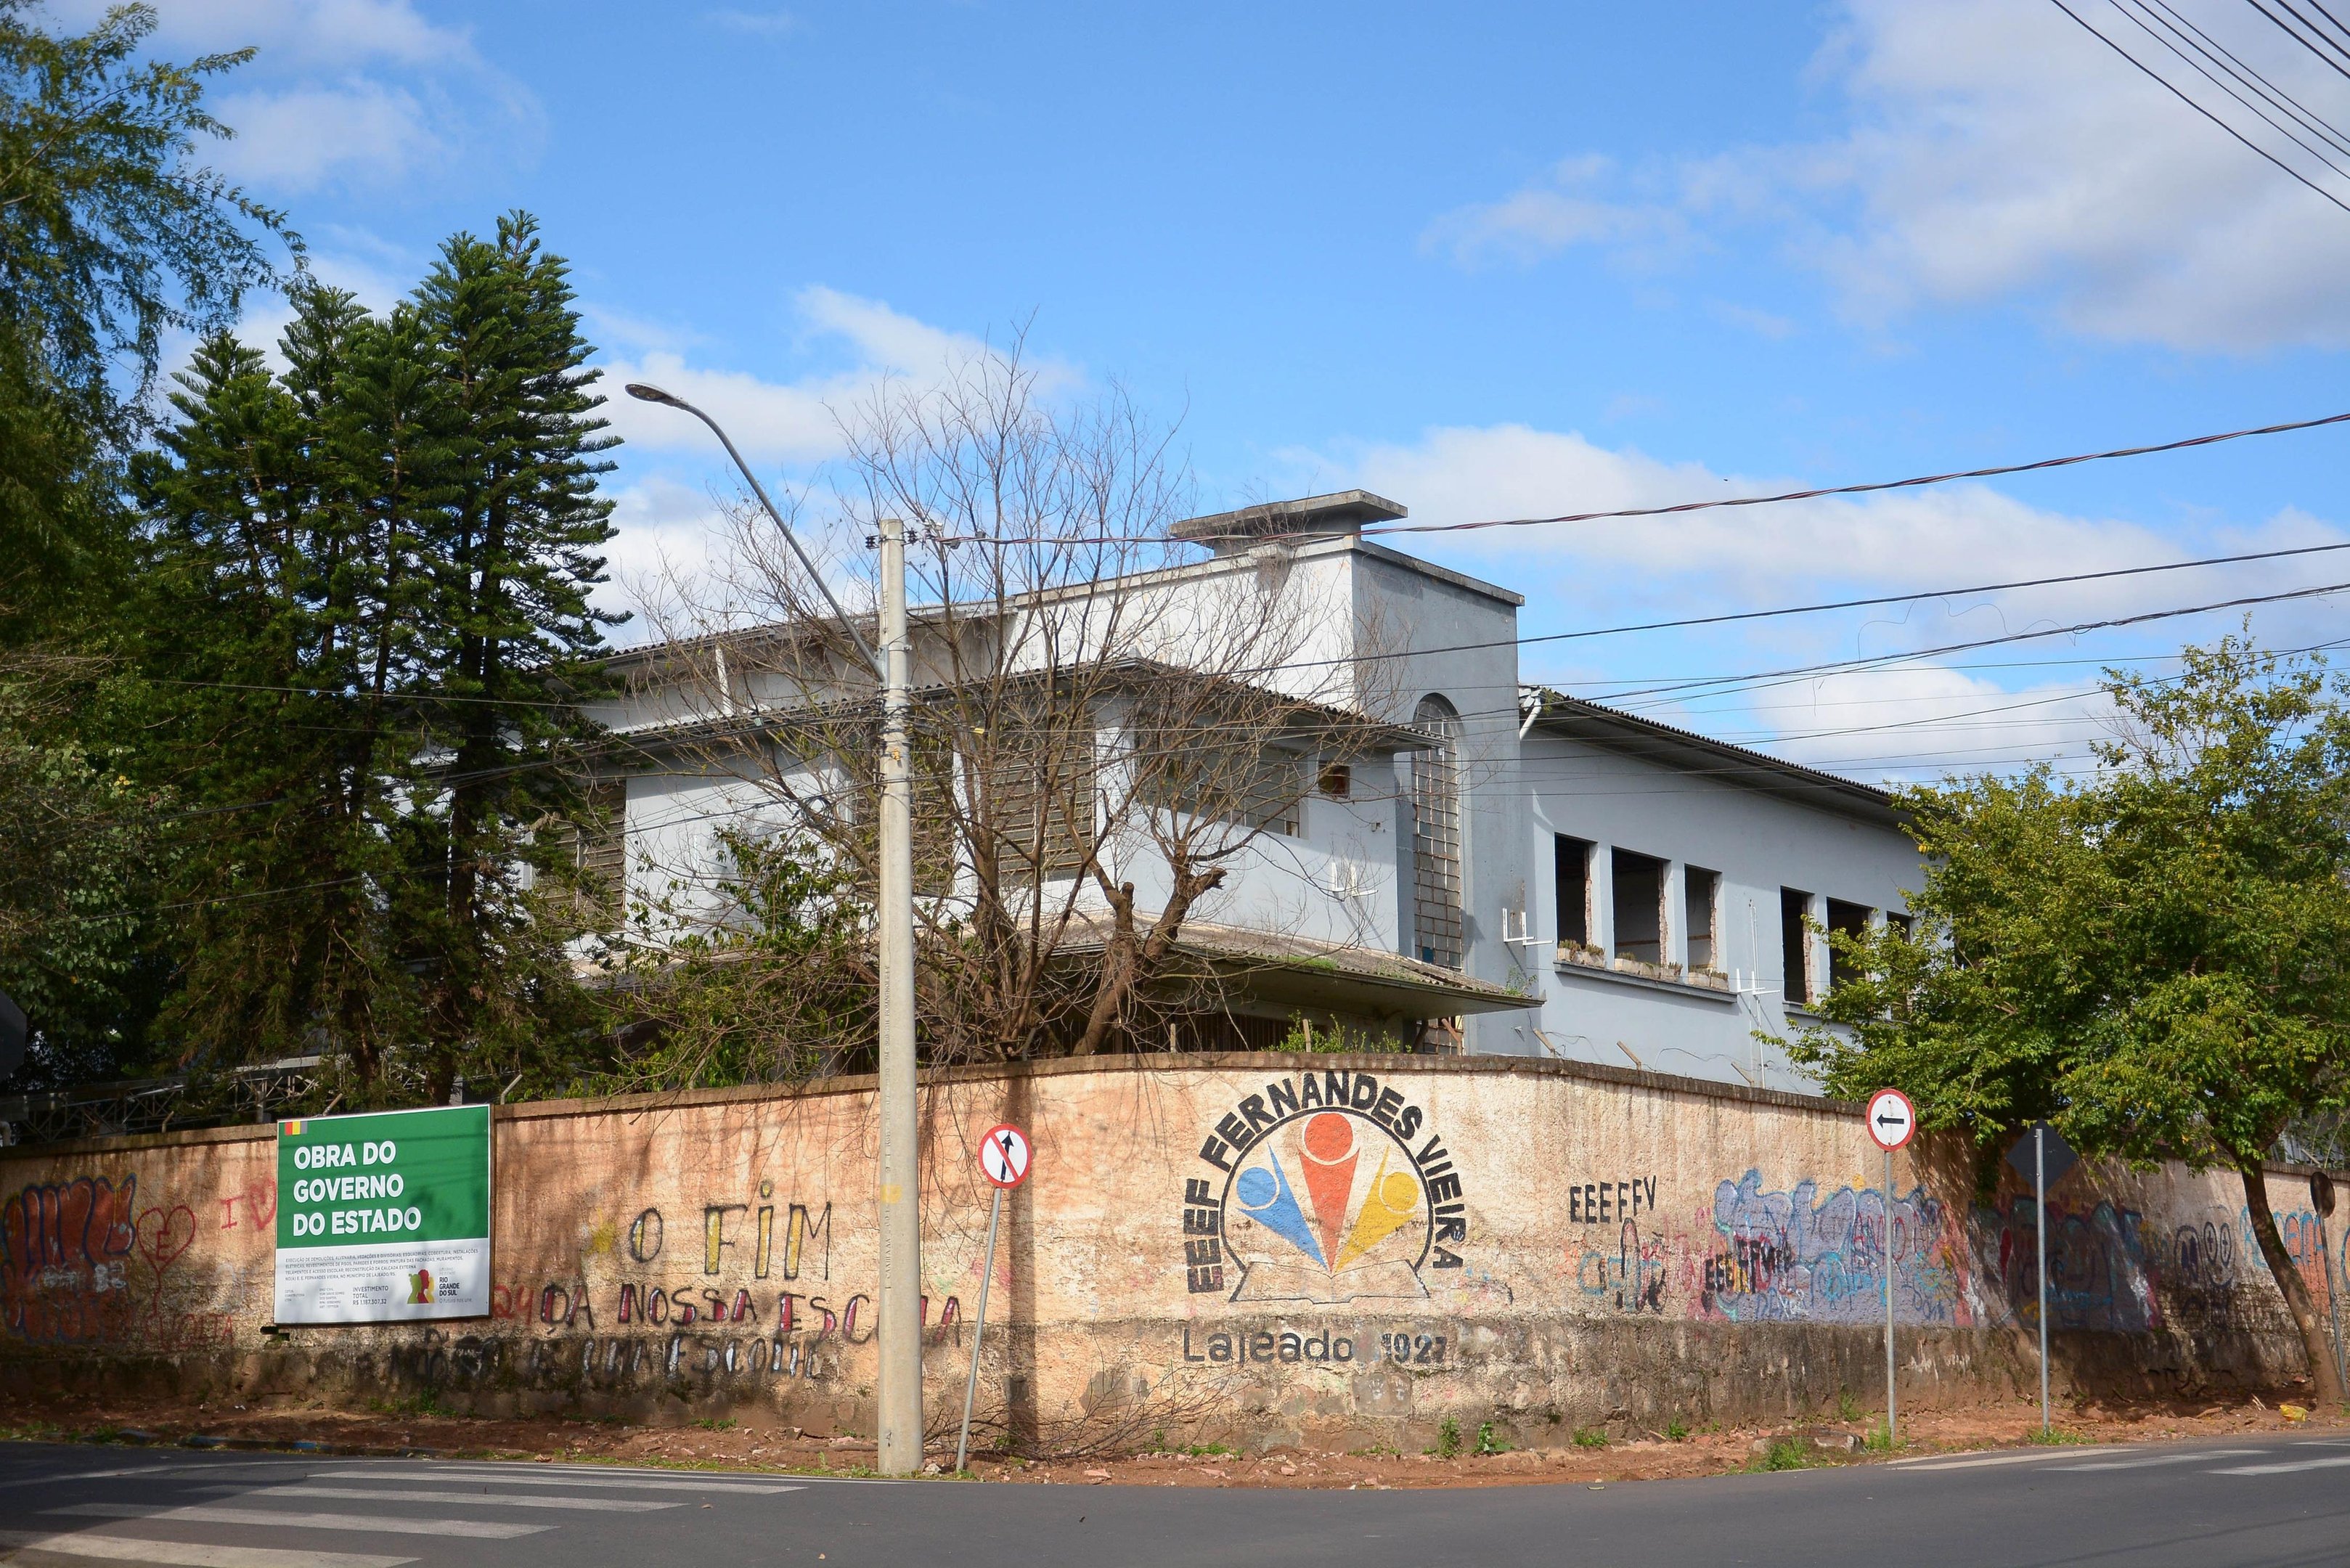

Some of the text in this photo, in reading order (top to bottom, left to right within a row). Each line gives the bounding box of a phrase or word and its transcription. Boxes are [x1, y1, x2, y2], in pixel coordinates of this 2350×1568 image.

[1199, 1070, 1423, 1174] FERNANDES
[294, 1140, 396, 1169] OBRA DO
[293, 1173, 404, 1203] GOVERNO
[1416, 1133, 1467, 1269] VIEIRA
[1569, 1175, 1657, 1225] EEEFFV
[293, 1206, 422, 1236] DO ESTADO
[629, 1206, 663, 1263] O
[1183, 1177, 1225, 1294] EEEF
[540, 1282, 595, 1330] DA
[619, 1283, 756, 1326] NOSSA
